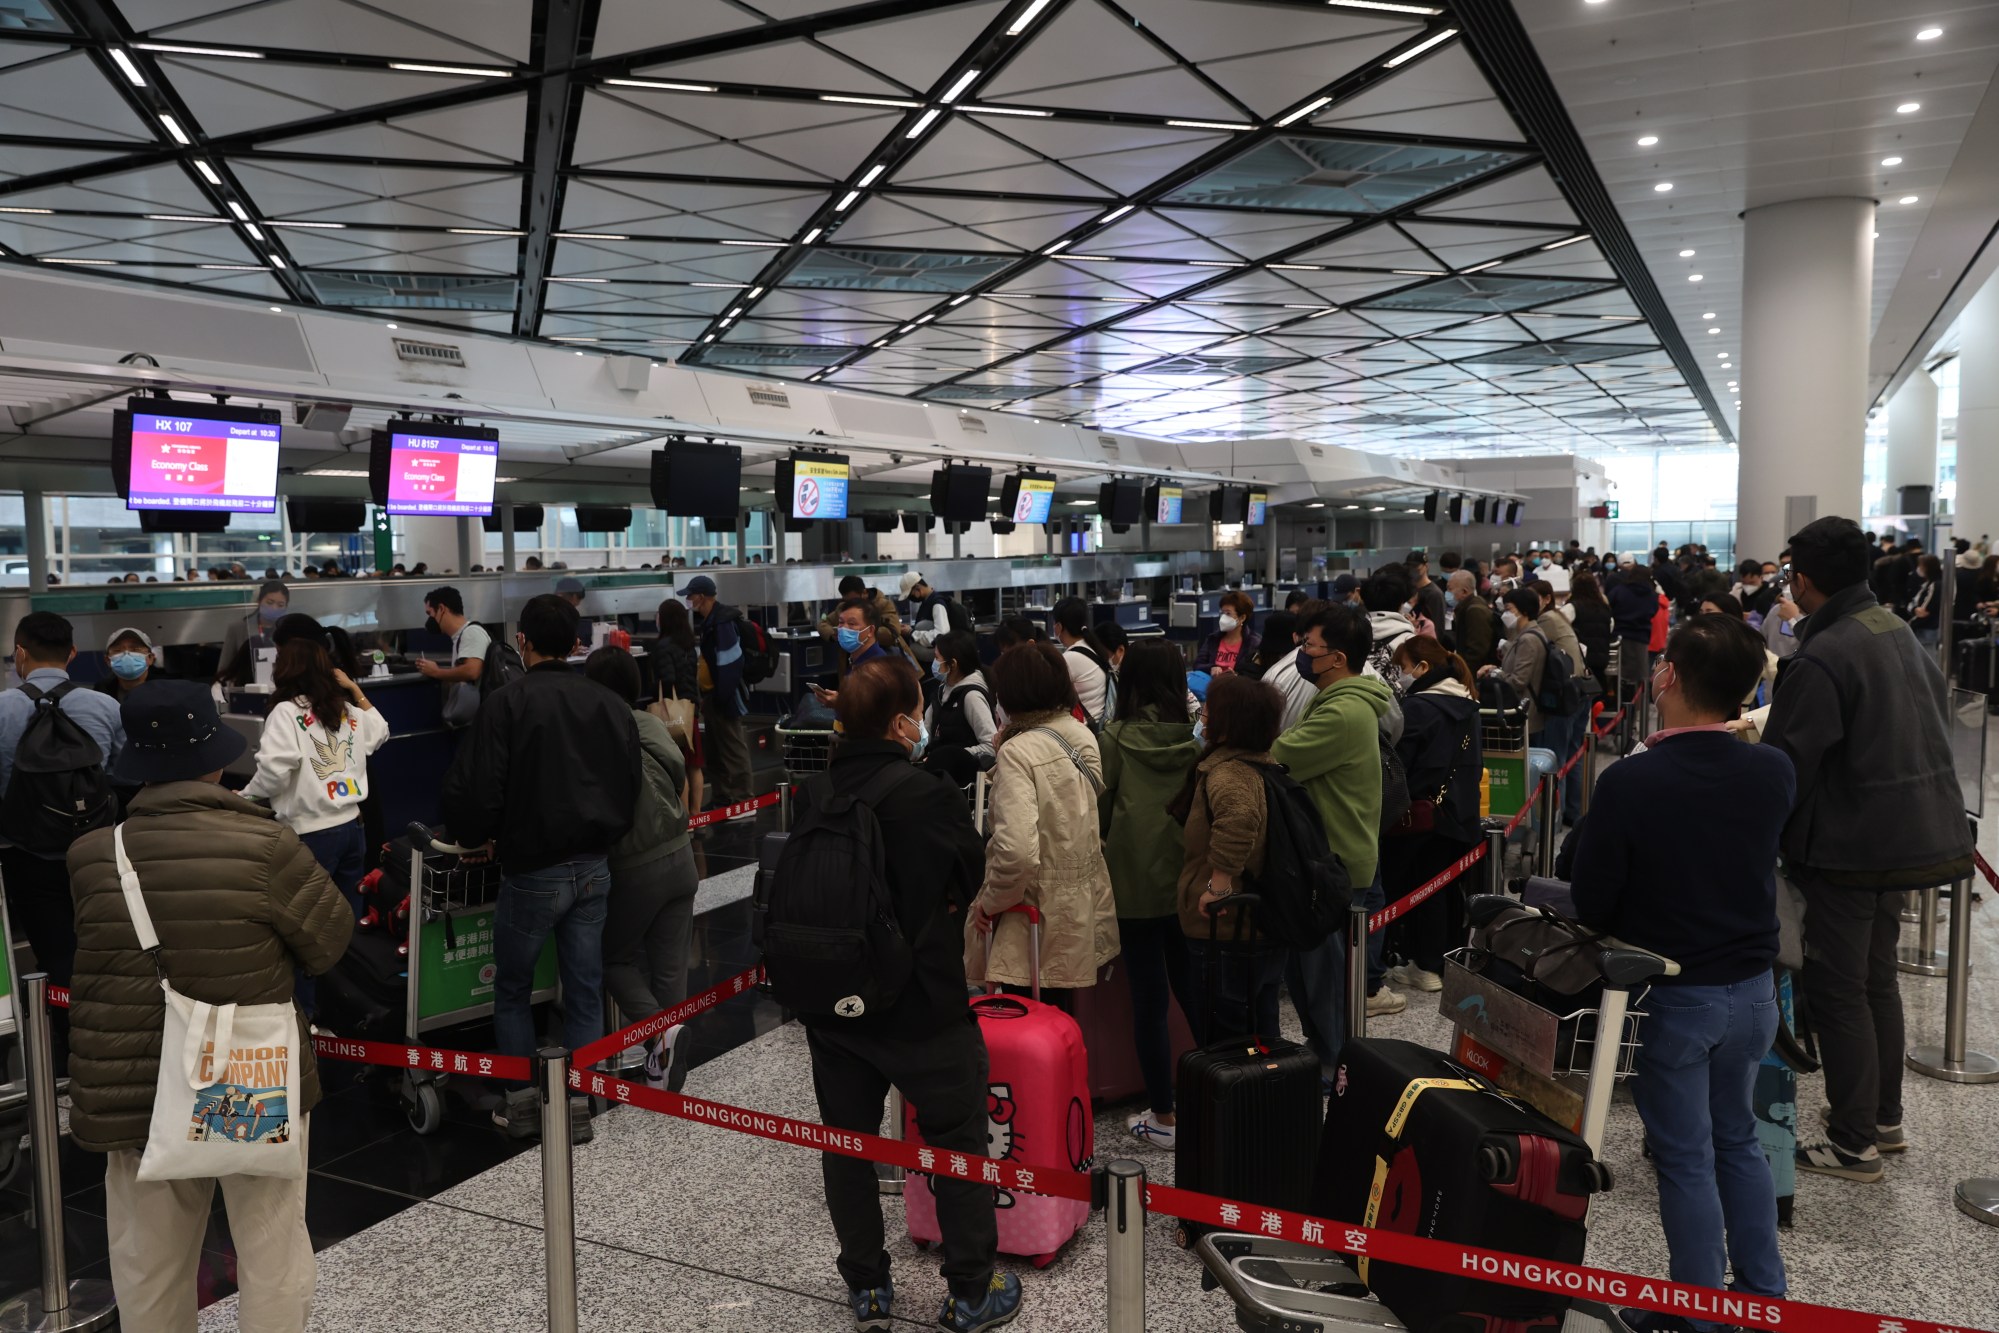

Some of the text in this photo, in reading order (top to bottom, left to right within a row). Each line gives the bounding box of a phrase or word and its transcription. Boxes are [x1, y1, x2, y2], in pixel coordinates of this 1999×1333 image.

[155, 419, 192, 432] HX 107
[230, 427, 250, 436] Depart
[408, 438, 439, 449] HU 8157
[151, 459, 208, 472] Economy Class
[404, 471, 445, 482] Economy Class
[133, 497, 142, 505] be
[143, 498, 171, 506] boarded.
[296, 709, 357, 732] PEE
[1409, 871, 1451, 906] HONGKONG AIRLINES
[623, 991, 717, 1045] HONGKONG AIRLINES
[202, 1041, 288, 1061] JNIOR
[406, 1048, 493, 1076] 香港航空
[1466, 1048, 1490, 1071] KLOOK
[682, 1099, 864, 1152] HONGKONG AIRLINES
[917, 1148, 1036, 1190] 香港航空
[1218, 1201, 1368, 1254] 香港航空
[1461, 1252, 1782, 1325] HONGKONG AIRLINES
